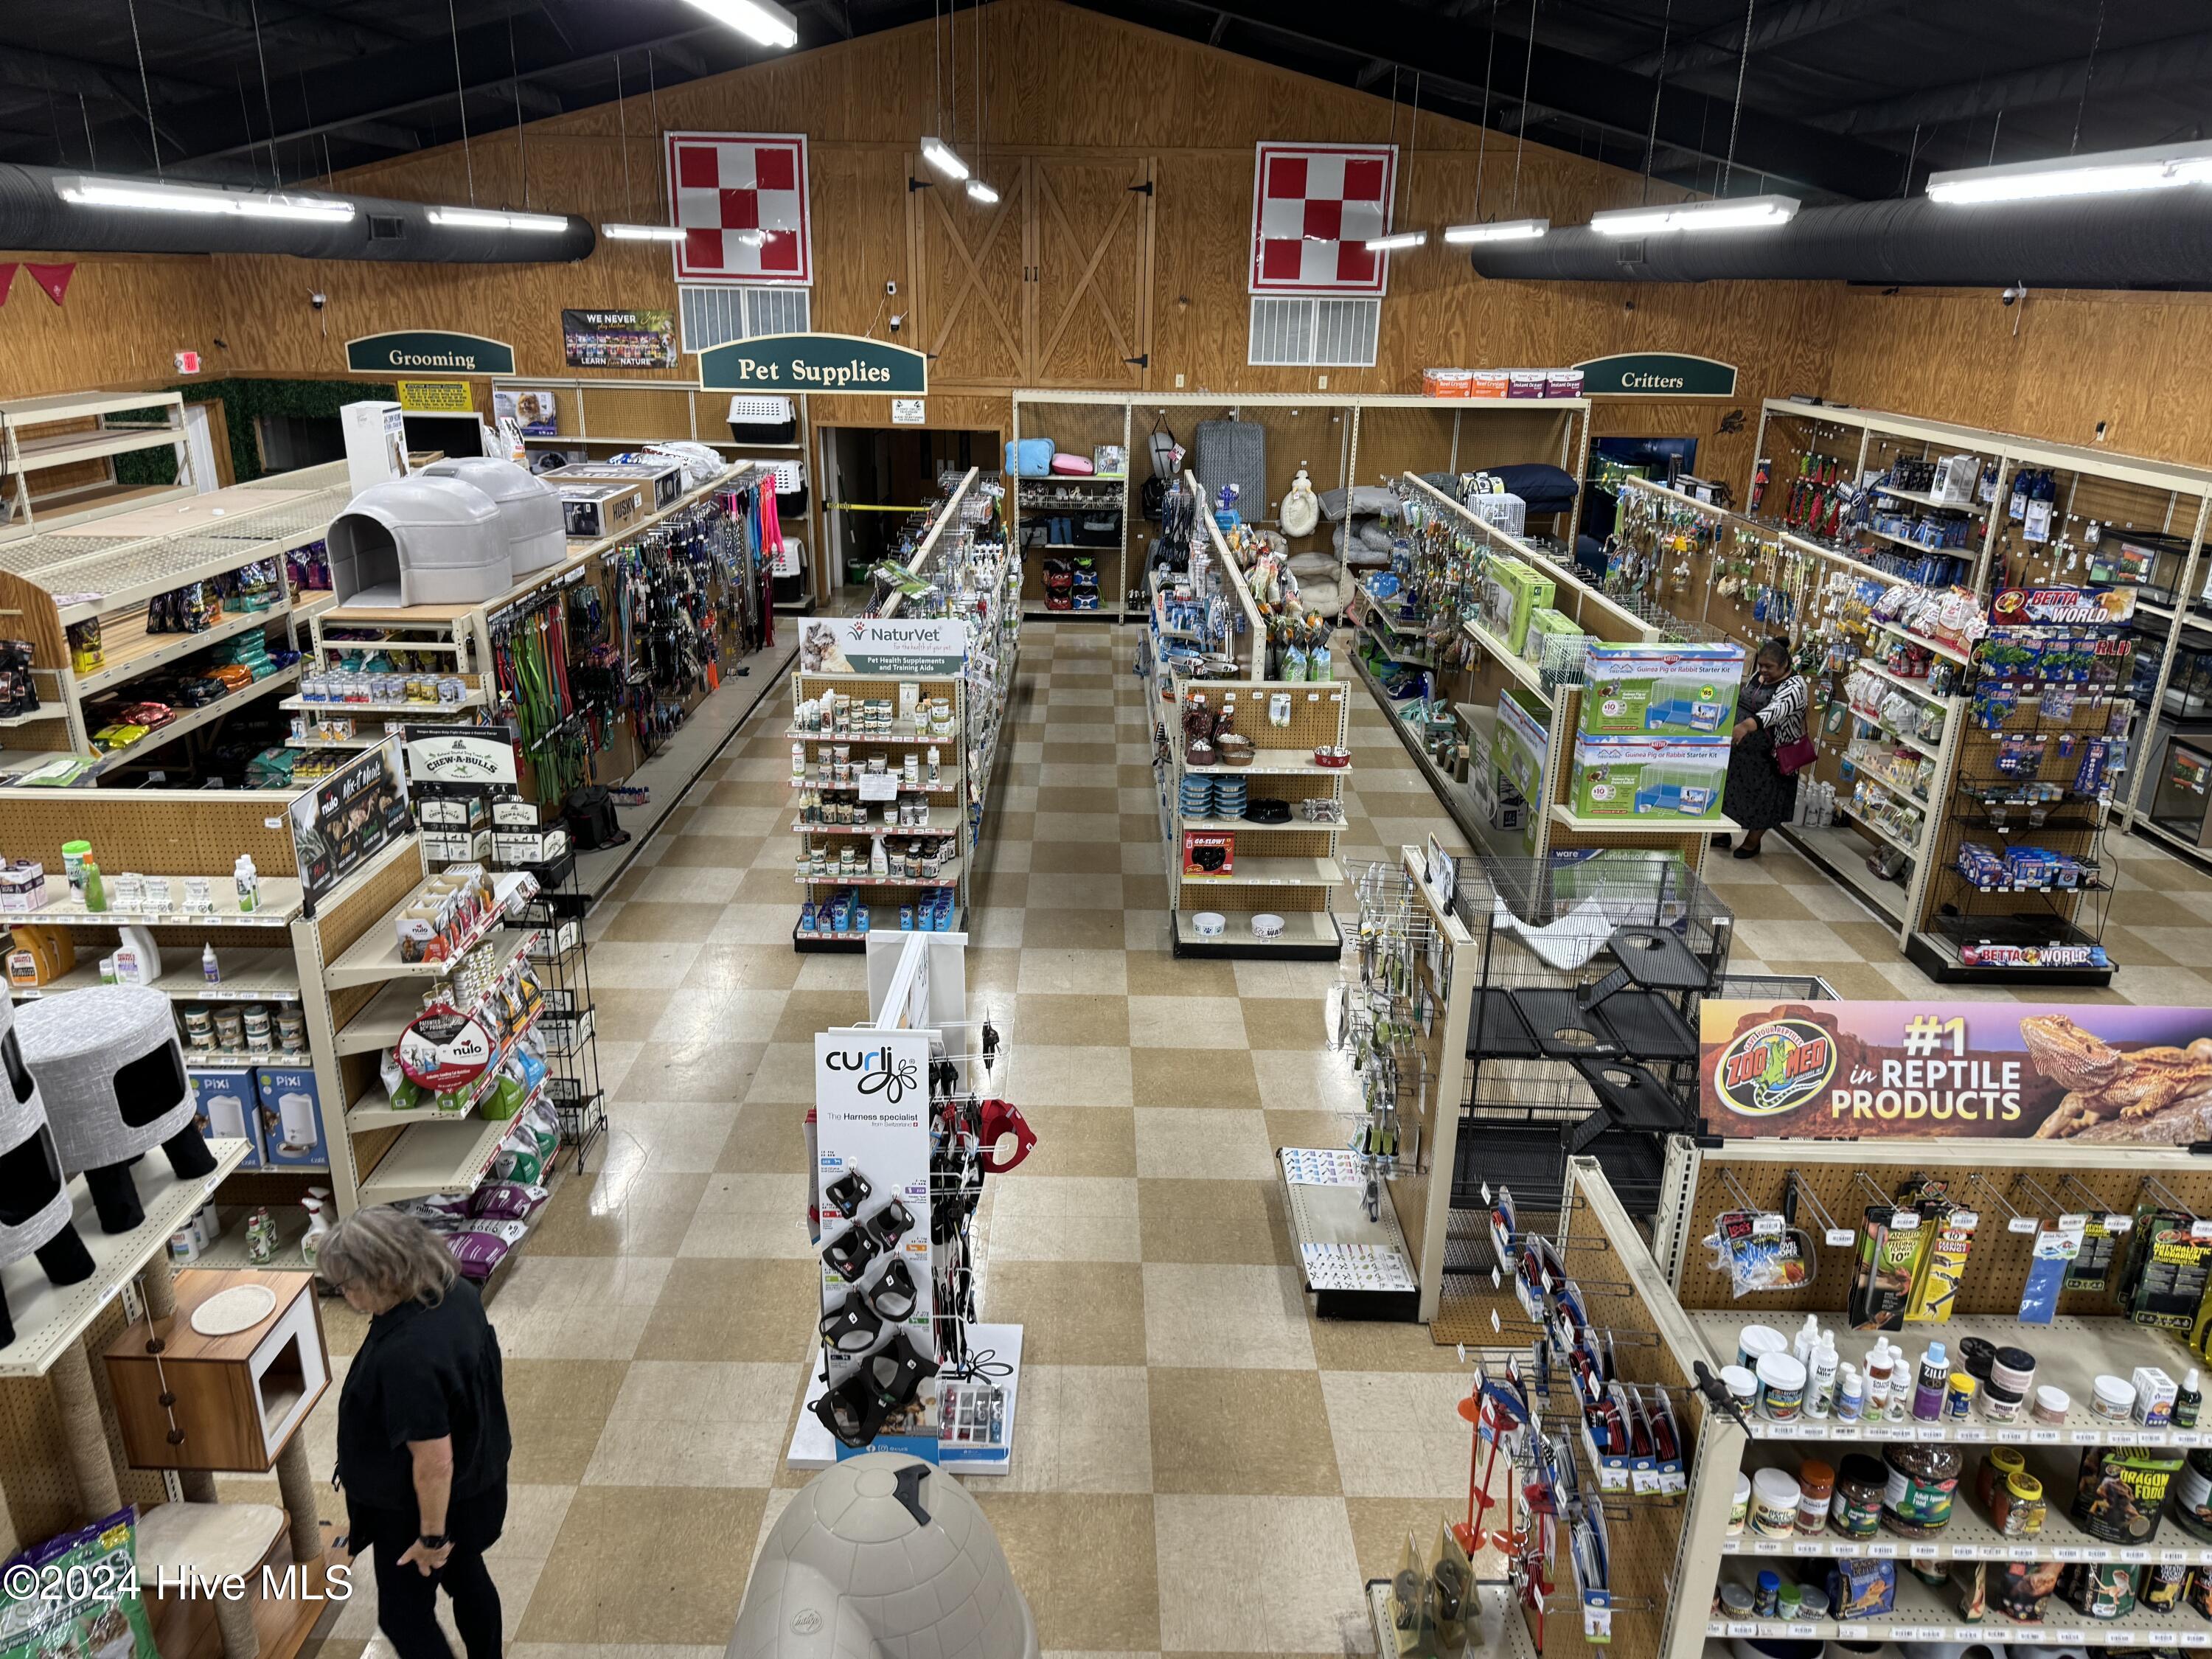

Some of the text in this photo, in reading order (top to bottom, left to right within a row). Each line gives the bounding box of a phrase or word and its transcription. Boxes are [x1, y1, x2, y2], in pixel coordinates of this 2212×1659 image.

[587, 314, 602, 323] WE
[605, 314, 636, 323] NEVER
[389, 349, 476, 370] Grooming
[621, 358, 650, 366] NATURE
[738, 358, 891, 386] Pet Supplies
[1621, 371, 1683, 389] Critters
[2031, 591, 2080, 606] BETTA
[2052, 608, 2109, 623] WORLD
[872, 628, 940, 641] NaturVet
[2095, 639, 2132, 656] RLD
[902, 657, 945, 665] Supplements
[1659, 666, 1669, 674] Pig
[321, 794, 338, 815] nulo
[1604, 850, 1643, 861] universal
[1982, 949, 2087, 962] BETTA WORLD
[1745, 1026, 1804, 1051] SAVE YOUR REPTILES
[1902, 1015, 1966, 1057] #1
[453, 1043, 481, 1056] nulo
[1728, 1039, 1826, 1086] ZOO MED
[1850, 1060, 2021, 1091] in REPTILE
[1832, 1089, 2021, 1121] PRODUCTS
[827, 1112, 918, 1123] The Harness specialist
[2120, 1470, 2170, 1487] DRAGON
[2135, 1484, 2166, 1500] FOOD
